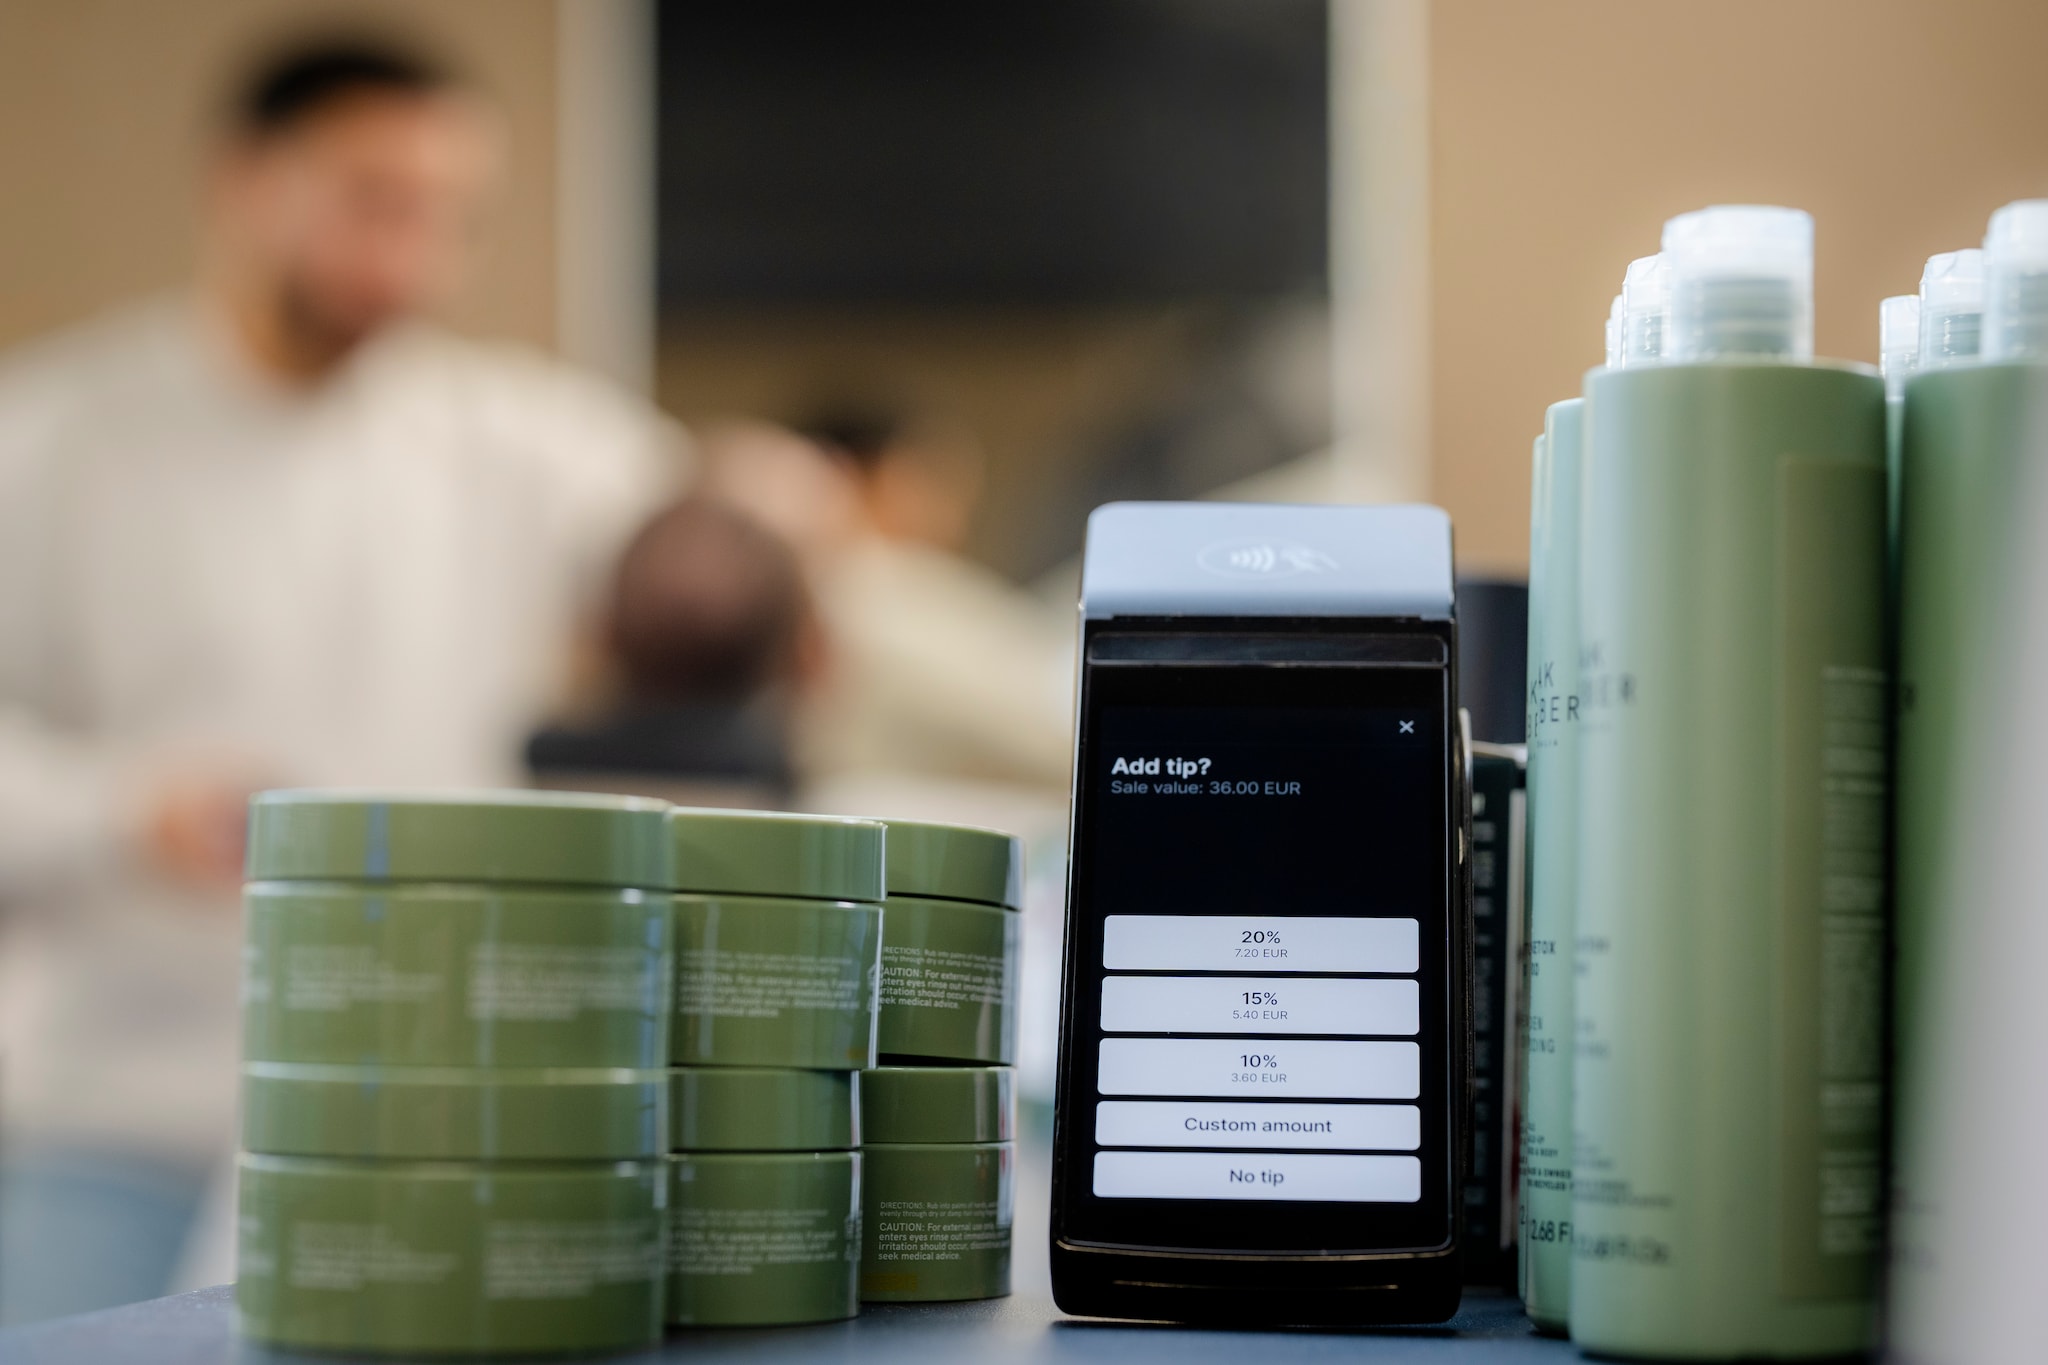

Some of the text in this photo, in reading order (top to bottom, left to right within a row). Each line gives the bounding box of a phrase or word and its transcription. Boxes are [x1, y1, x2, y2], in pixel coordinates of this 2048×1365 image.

[1111, 757, 1212, 779] Add tip?
[1111, 780, 1301, 795] Sale value: 36.00 EUR
[1241, 930, 1281, 944] 20%
[1234, 949, 1288, 958] 7.20 EUR
[925, 969, 939, 979] For
[906, 980, 926, 988] eyes
[917, 989, 946, 998] should
[1242, 992, 1278, 1005] 15%
[879, 996, 897, 1004] eek
[898, 998, 932, 1007] medical
[1232, 1010, 1288, 1020] 5.40 EUR
[1240, 1055, 1277, 1068] 10%
[1231, 1073, 1287, 1083] 3.60 EUR
[1184, 1117, 1333, 1133] Custom amount
[1229, 1169, 1284, 1186] No tip
[879, 1222, 925, 1231] CAUTION:
[927, 1223, 941, 1231] For
[879, 1233, 907, 1241] enters
[909, 1234, 928, 1243] eyes
[929, 1232, 949, 1241] rinse
[878, 1241, 918, 1251] irritation
[919, 1242, 946, 1251] should
[878, 1252, 899, 1261] seek
[901, 1252, 934, 1261] medical
